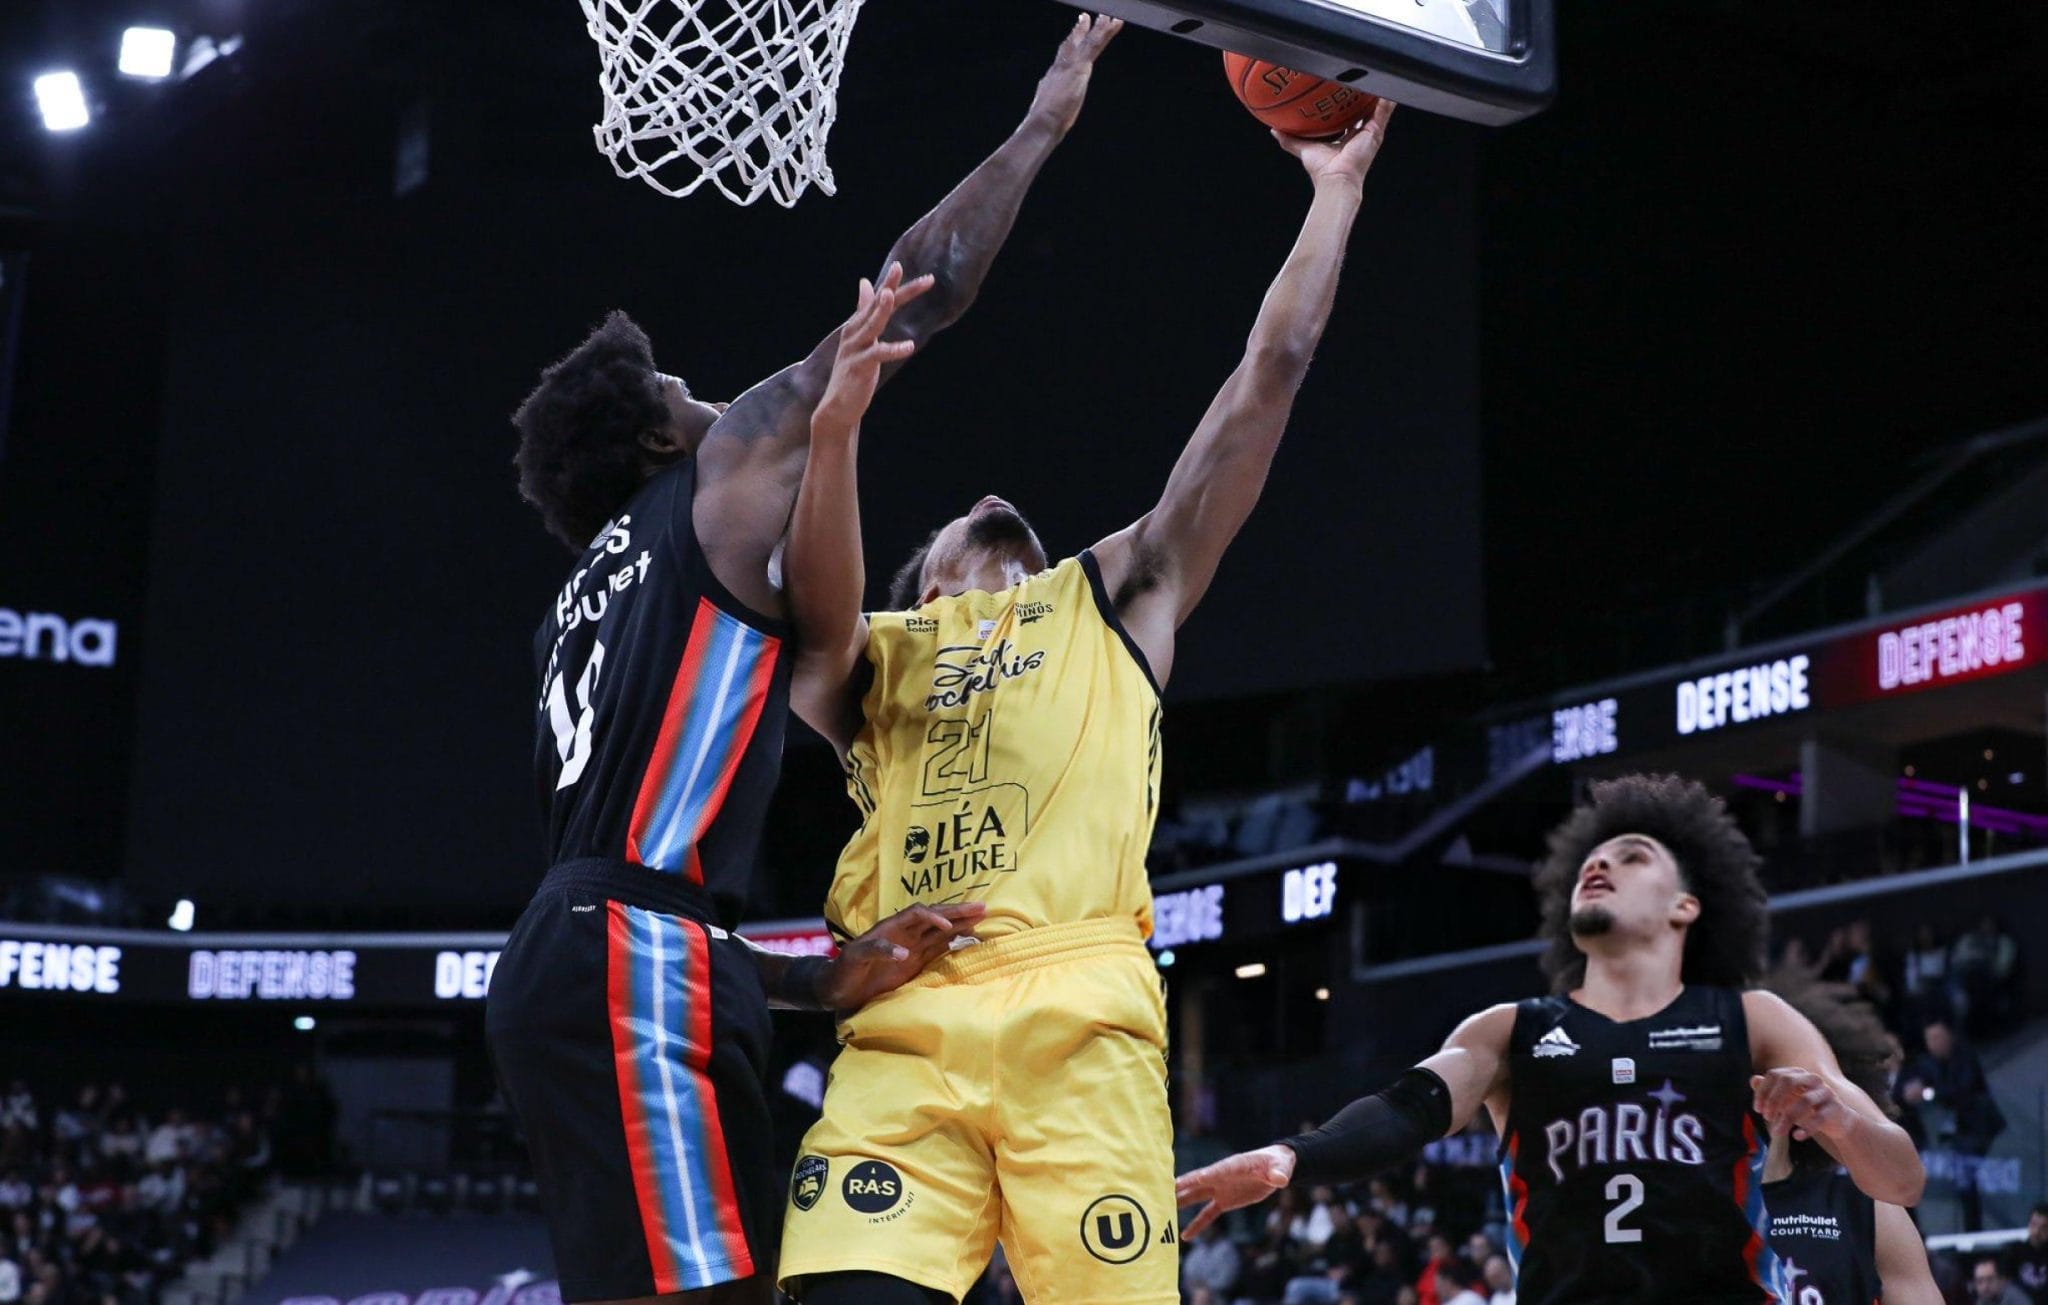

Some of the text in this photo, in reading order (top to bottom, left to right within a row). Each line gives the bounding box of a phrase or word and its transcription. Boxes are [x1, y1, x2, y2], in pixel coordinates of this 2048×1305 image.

[0, 609, 118, 667] ena
[1676, 654, 1811, 736] DEFENSE
[1877, 602, 2025, 691] DEFENSE
[921, 708, 993, 796] 21
[934, 800, 1006, 860] LÉA
[900, 843, 1006, 897] NATURE
[187, 949, 357, 1000] DEFENSE
[1544, 1103, 1705, 1185] PARIS
[1096, 1212, 1136, 1250] U
[1604, 1173, 1645, 1244] 2
